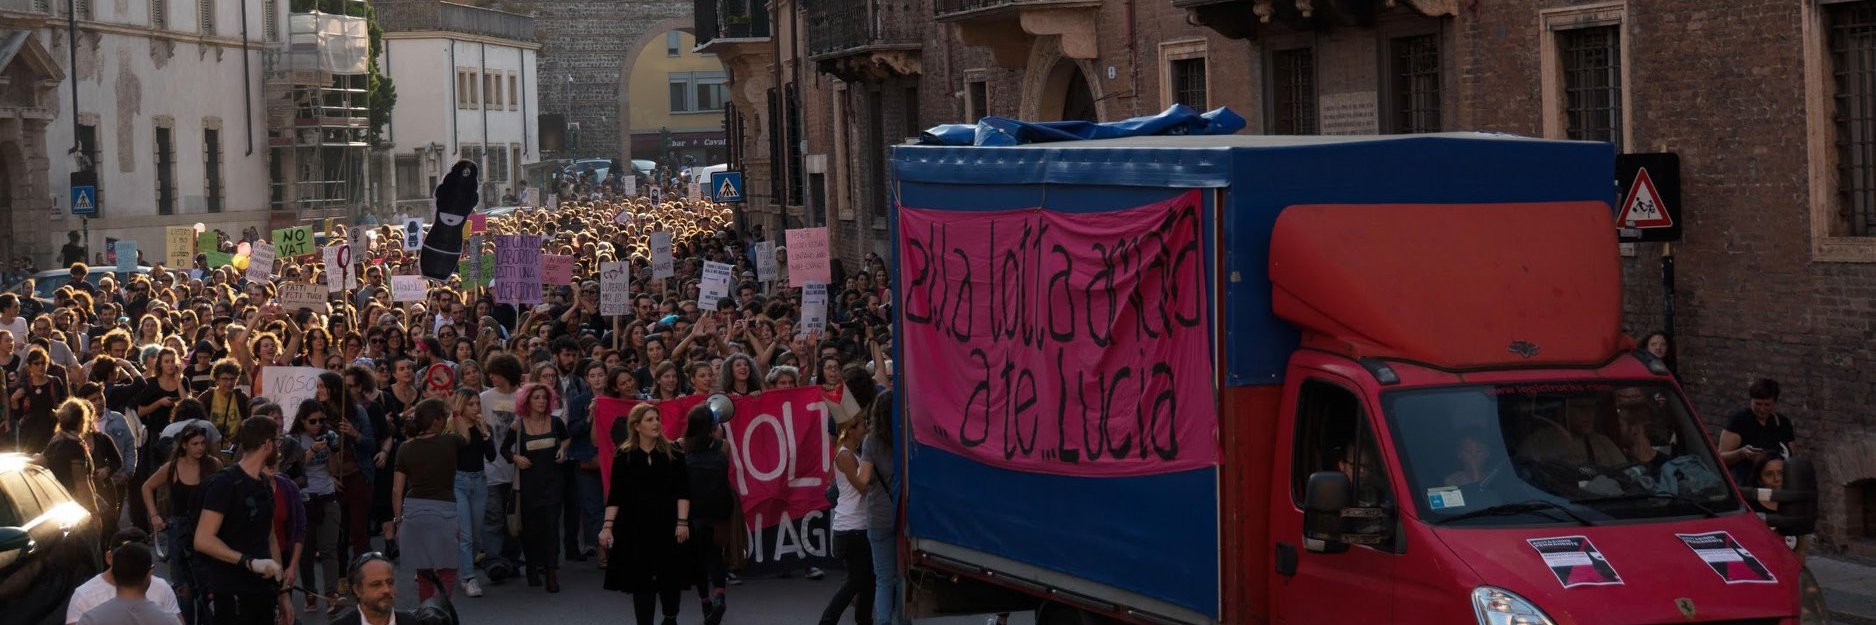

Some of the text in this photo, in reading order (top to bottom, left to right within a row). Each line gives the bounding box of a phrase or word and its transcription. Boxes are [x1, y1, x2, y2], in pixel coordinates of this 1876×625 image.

[283, 229, 305, 242] NO
[496, 235, 541, 248] SEI CONTRO
[279, 242, 307, 257] VAT
[522, 266, 536, 279] UNA
[496, 281, 542, 300] VASECTOMIA
[905, 222, 973, 343] alla
[990, 216, 1075, 350] lotta
[774, 510, 836, 561] AG
